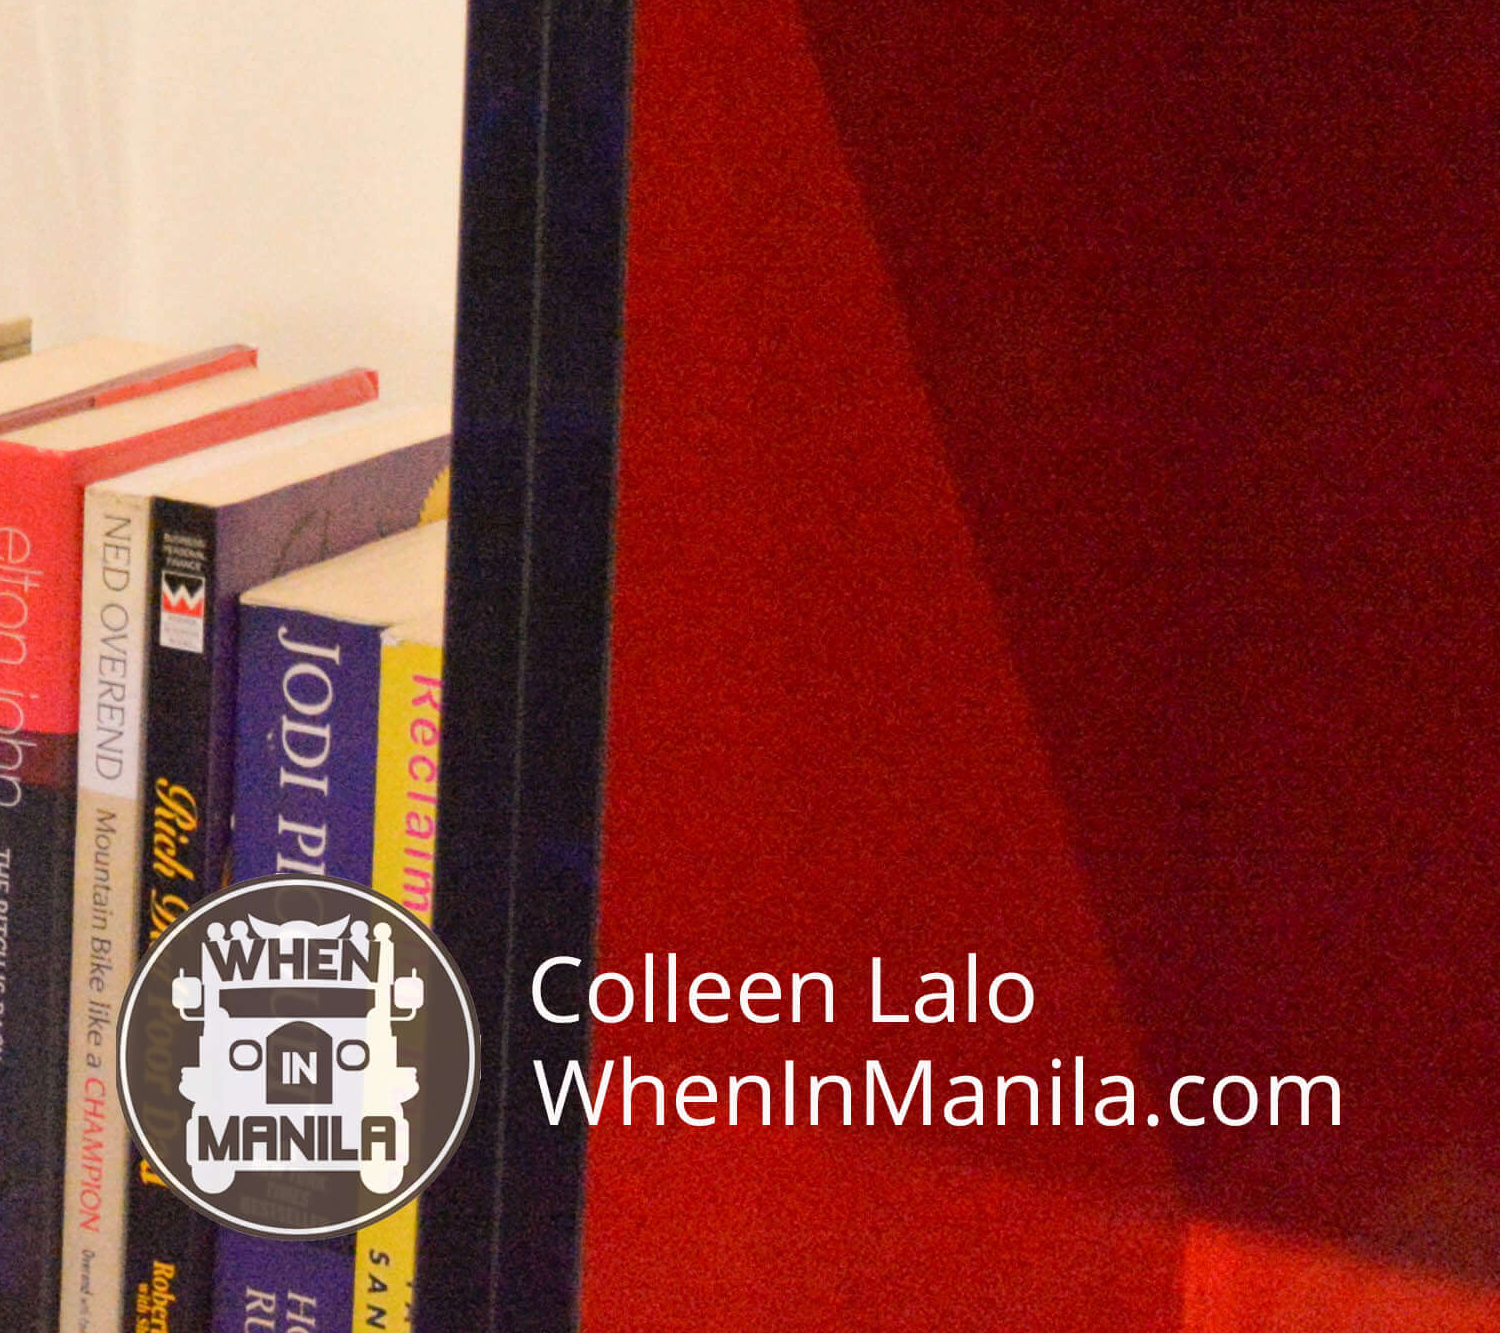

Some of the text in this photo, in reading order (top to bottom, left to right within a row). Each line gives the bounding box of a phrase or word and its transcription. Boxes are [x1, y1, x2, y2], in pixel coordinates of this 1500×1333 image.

[94, 514, 132, 785] NED OVEREND
[278, 626, 342, 799] JODI
[152, 776, 199, 882] Rich
[78, 807, 118, 1233] Mountain Bike like a CHAMPION
